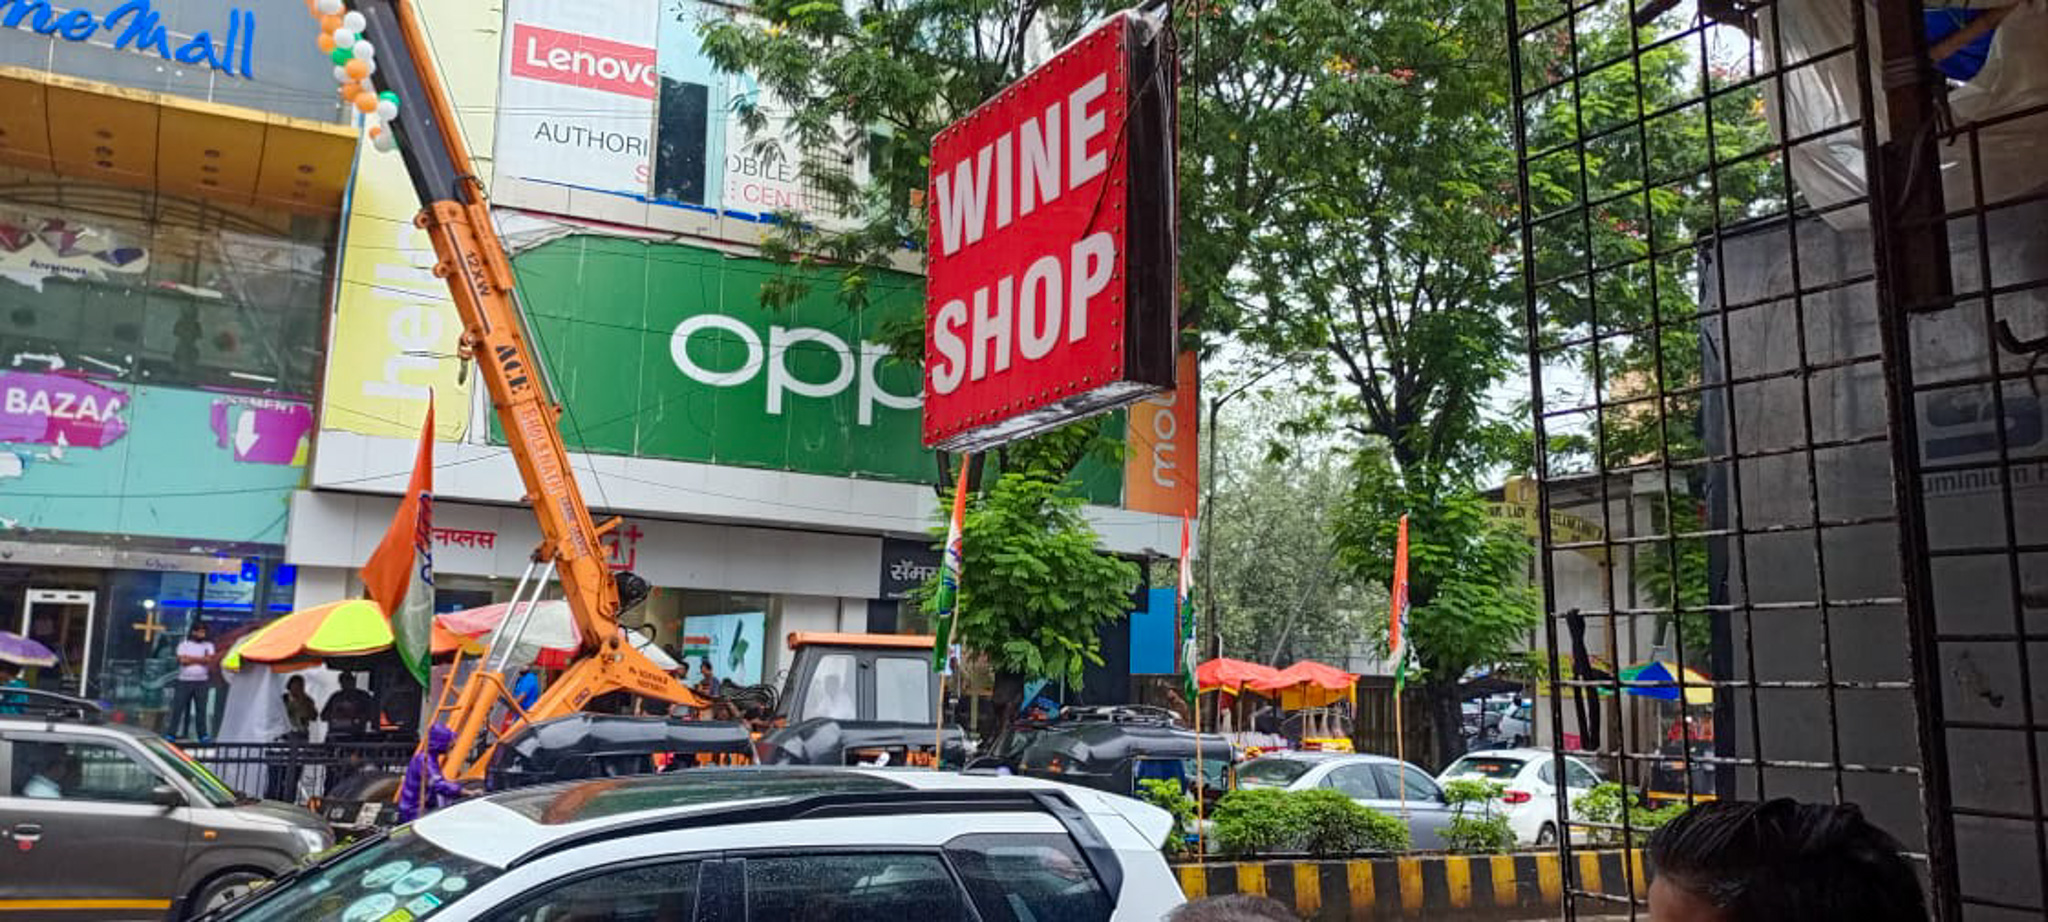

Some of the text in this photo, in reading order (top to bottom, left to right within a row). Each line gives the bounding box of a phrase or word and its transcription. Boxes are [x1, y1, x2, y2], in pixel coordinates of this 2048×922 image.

[103, 0, 254, 79] Mall
[534, 121, 648, 157] AUTHORI
[935, 72, 1108, 258] WINE
[466, 250, 491, 297] 12XW
[931, 231, 1115, 395] SHOP
[496, 344, 531, 395] ACE
[670, 314, 926, 426] opp
[432, 527, 497, 549] नप्लस
